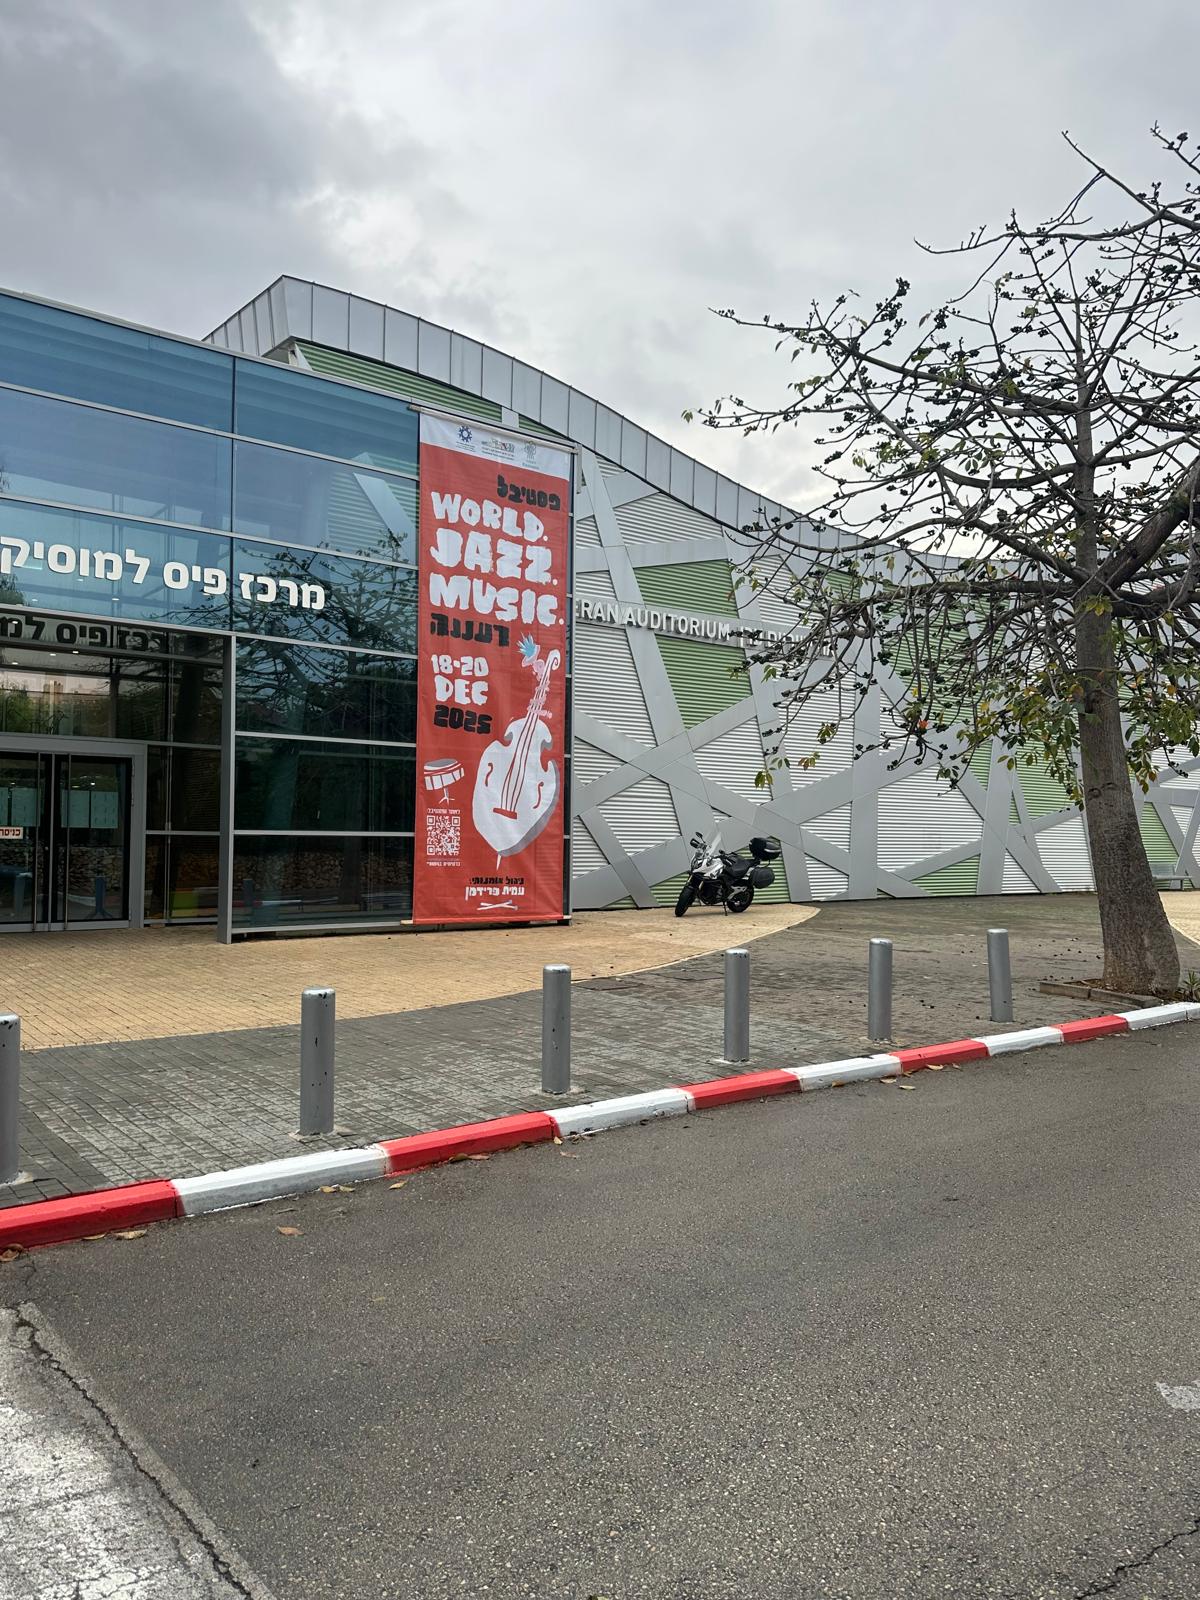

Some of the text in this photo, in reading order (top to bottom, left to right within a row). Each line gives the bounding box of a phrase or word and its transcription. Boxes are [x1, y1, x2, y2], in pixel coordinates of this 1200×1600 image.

[497, 474, 561, 511] פסטיבל
[430, 491, 549, 542] WORLD.
[430, 527, 558, 586] JAZZ.
[163, 561, 227, 596] פיס
[239, 572, 325, 611] מרכז
[429, 572, 564, 627] MUSIC.
[430, 613, 510, 647] רעננה
[623, 606, 731, 641] AUDITORIUM
[434, 674, 489, 705] DEC
[433, 704, 493, 734] 2025
[465, 886, 525, 901] עמית פרידמן
